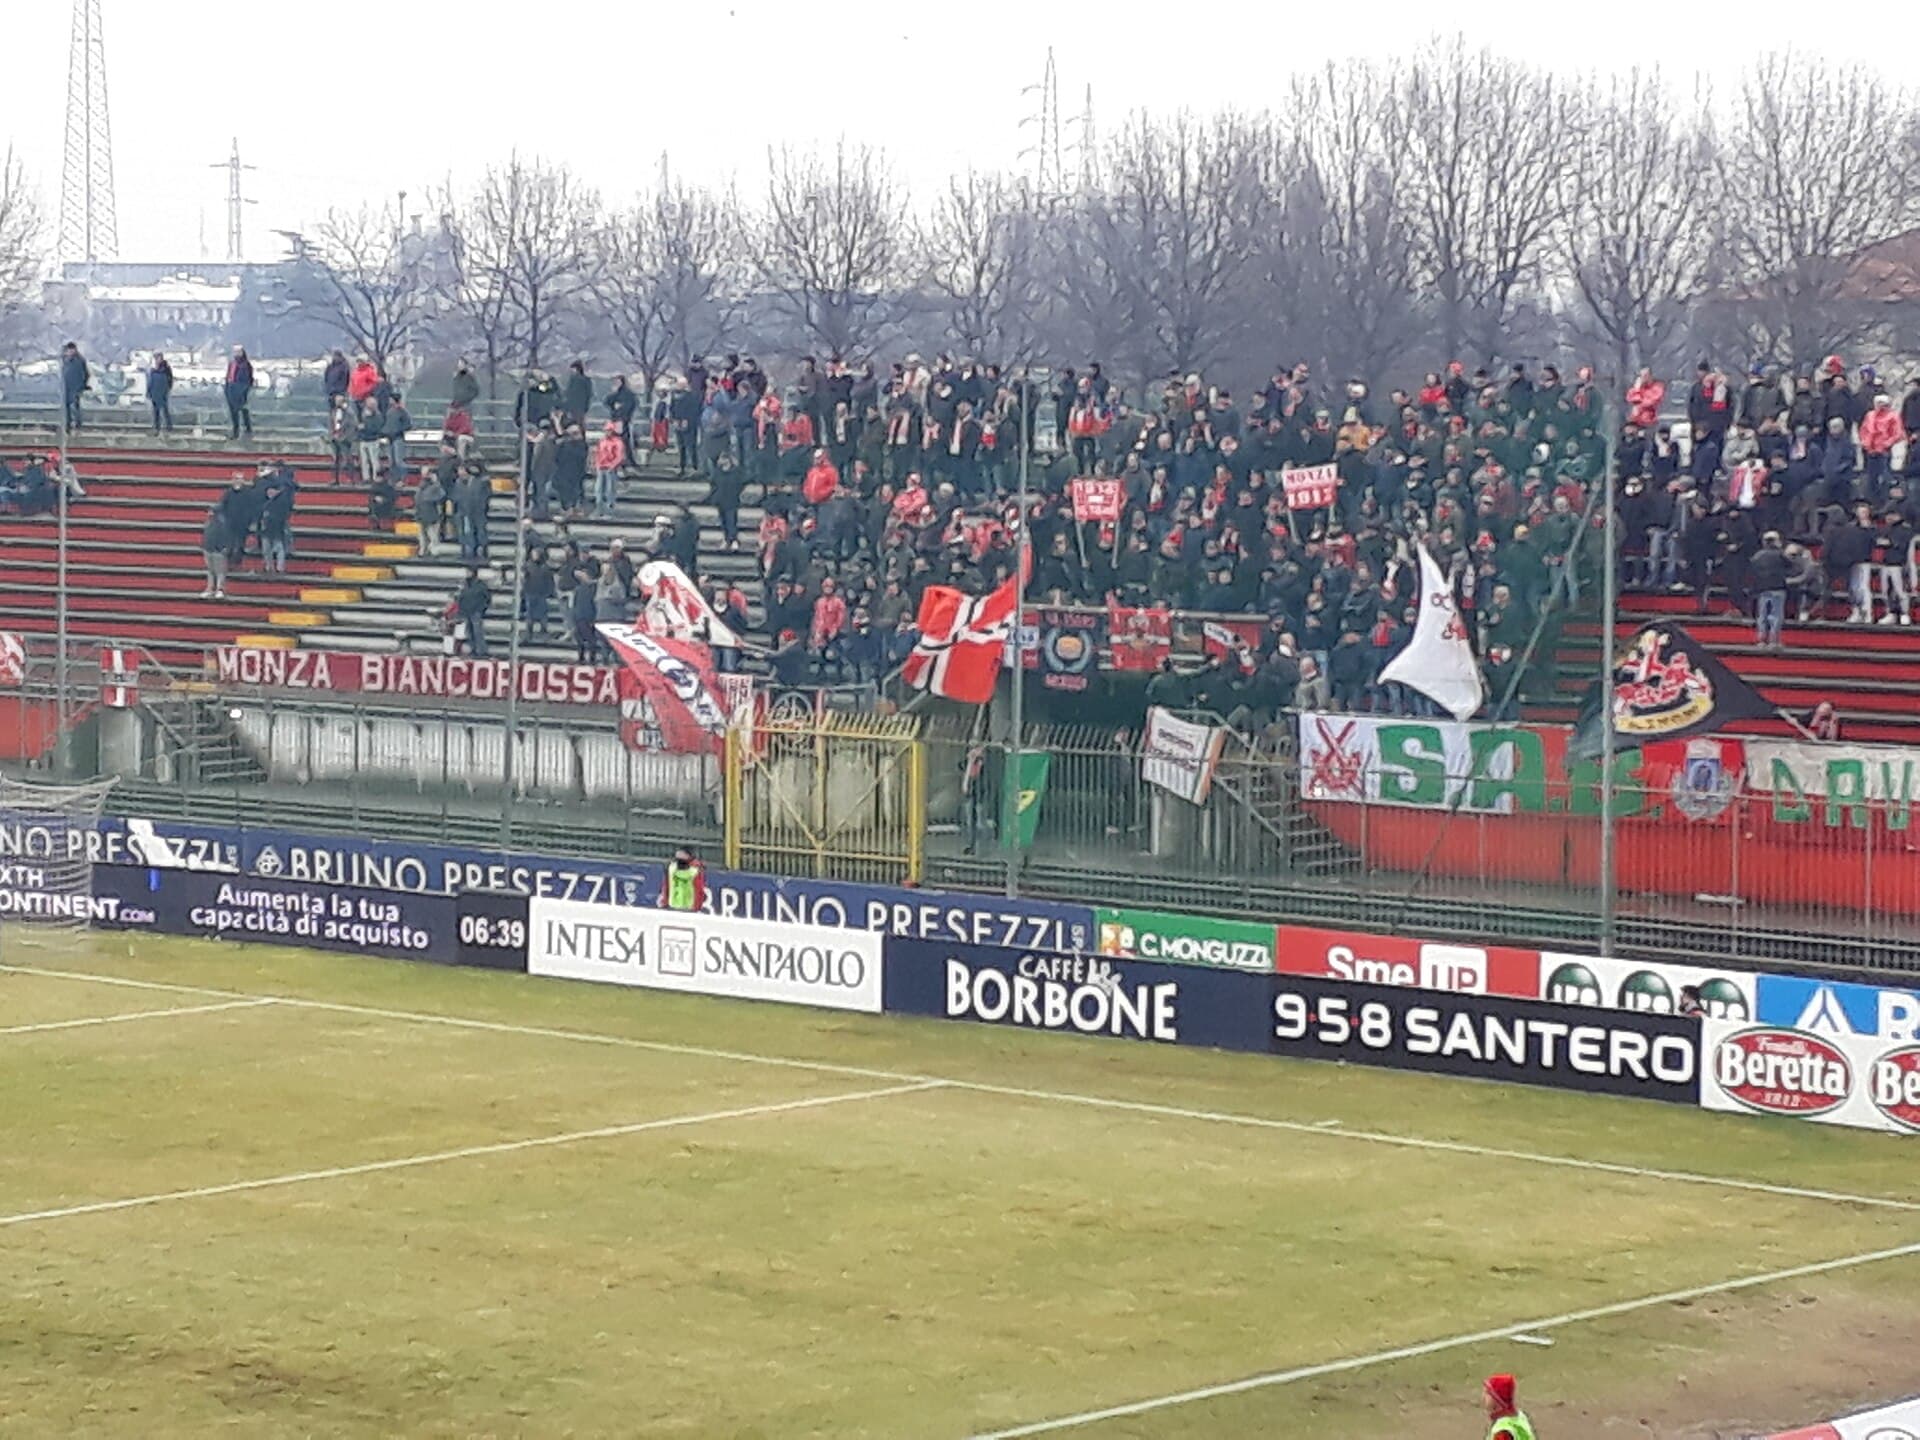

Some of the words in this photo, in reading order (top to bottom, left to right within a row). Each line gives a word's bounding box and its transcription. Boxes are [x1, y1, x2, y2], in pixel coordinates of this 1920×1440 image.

[216, 648, 332, 688] MONZA
[361, 655, 620, 705] BIANCOROSSA
[67, 829, 220, 868] PRESZZI
[217, 883, 324, 914] Aumenta
[331, 893, 353, 918] la
[359, 896, 400, 922] tua
[290, 848, 427, 892] BRUNO
[443, 860, 616, 906] PRESEZZI
[191, 905, 290, 931] capacità
[295, 910, 319, 936] di
[324, 917, 429, 949] acquisto
[460, 915, 525, 948] 06:39
[546, 919, 646, 965] INTESA
[704, 936, 865, 988] SANPAOLO
[868, 901, 1062, 951] PRESEZZI
[946, 958, 1178, 1041] BORBONE
[1405, 1006, 1695, 1083] SANTERO
[1720, 1041, 1847, 1097] Beretta
